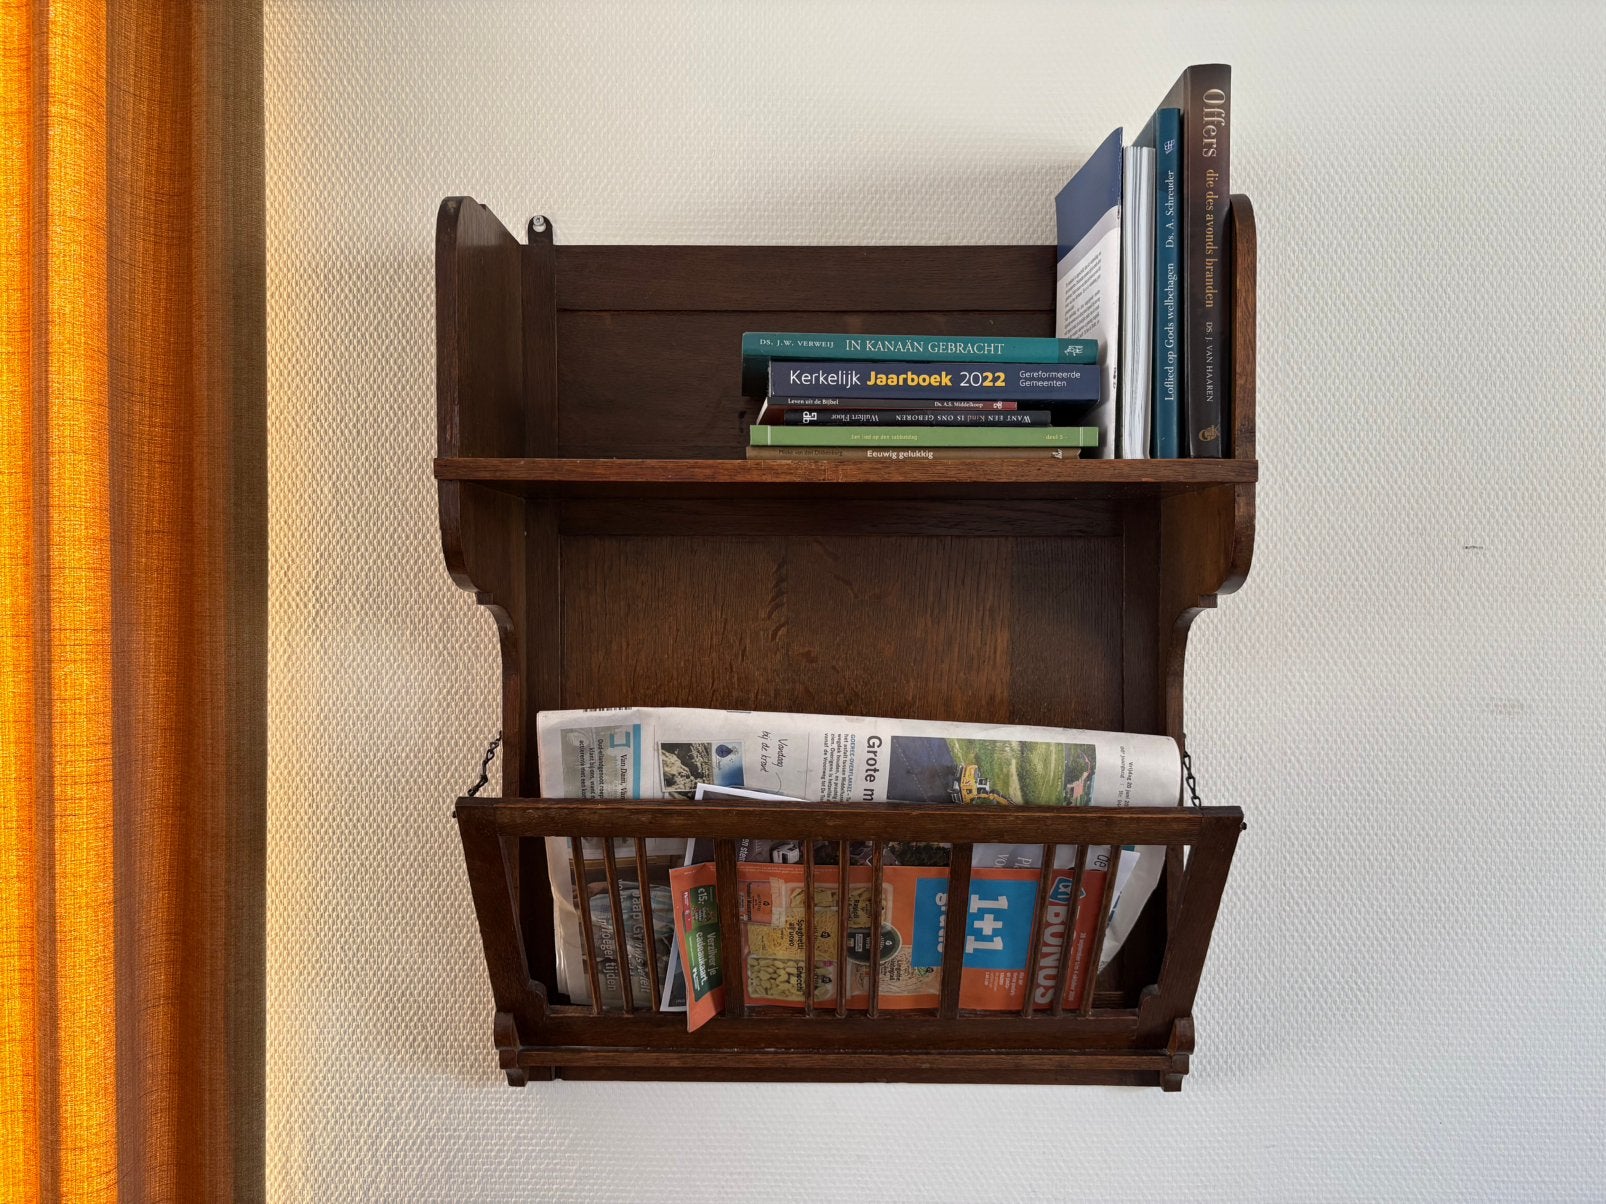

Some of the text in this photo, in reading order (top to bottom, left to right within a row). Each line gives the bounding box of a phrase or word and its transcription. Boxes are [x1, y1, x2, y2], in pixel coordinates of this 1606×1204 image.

[1202, 88, 1225, 158] Offers
[1164, 170, 1174, 248] Ds. A. Schreuder
[1205, 170, 1218, 308] die des avonds branden
[760, 338, 774, 346] DS.
[797, 340, 834, 348] VERWEIJ
[1164, 263, 1178, 400] Loflied op Gods welbehagen
[845, 339, 1005, 354] IN KANAÄN GEBRACHT
[790, 370, 1006, 388] Kerkelijk Jaarboek 2022
[1019, 370, 1081, 378] Gereformeerde
[1019, 378, 1067, 387] Gemeenten
[1206, 372, 1214, 402] HAAREN
[831, 414, 879, 422] Wulfert Floor
[967, 414, 985, 422] Kind
[1004, 415, 1031, 423] WANT
[867, 450, 934, 460] Eeuwig gelukkig
[761, 742, 770, 752] de
[620, 754, 628, 767] Van
[865, 735, 882, 783] Grote
[796, 920, 804, 950] Spaghetti
[965, 894, 1008, 954] 1+1
[696, 932, 708, 986] cadeaukaart.
[707, 932, 719, 976] Verzilver je
[603, 962, 618, 990] tijden
